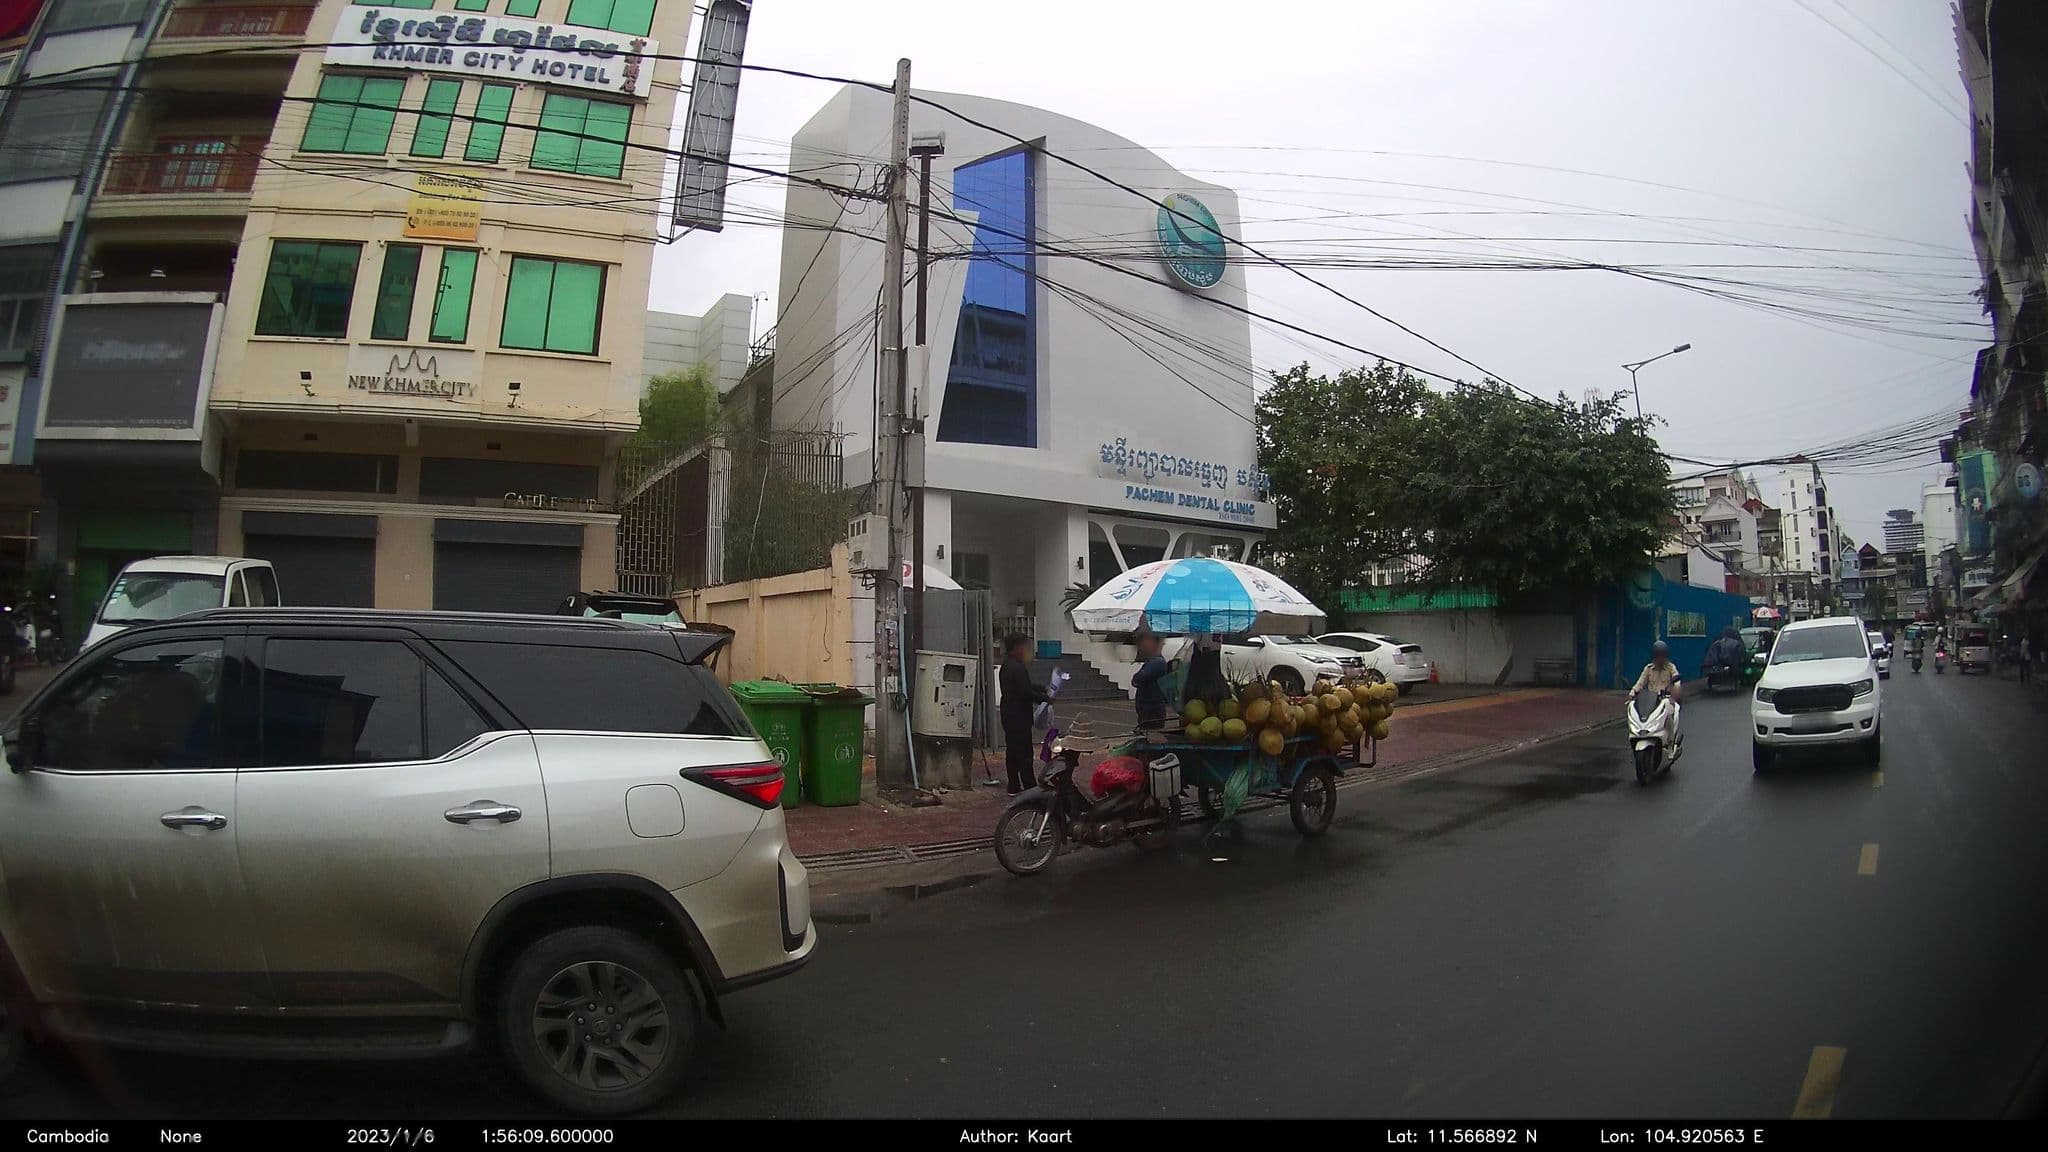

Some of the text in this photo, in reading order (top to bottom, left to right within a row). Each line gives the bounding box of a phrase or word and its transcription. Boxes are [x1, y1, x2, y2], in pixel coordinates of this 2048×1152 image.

[373, 44, 610, 84] KHMER CITY HOTEL
[348, 375, 477, 397] NEW KHMER CITY
[1126, 485, 1256, 516] PACHEM DENTAL CLINIC
